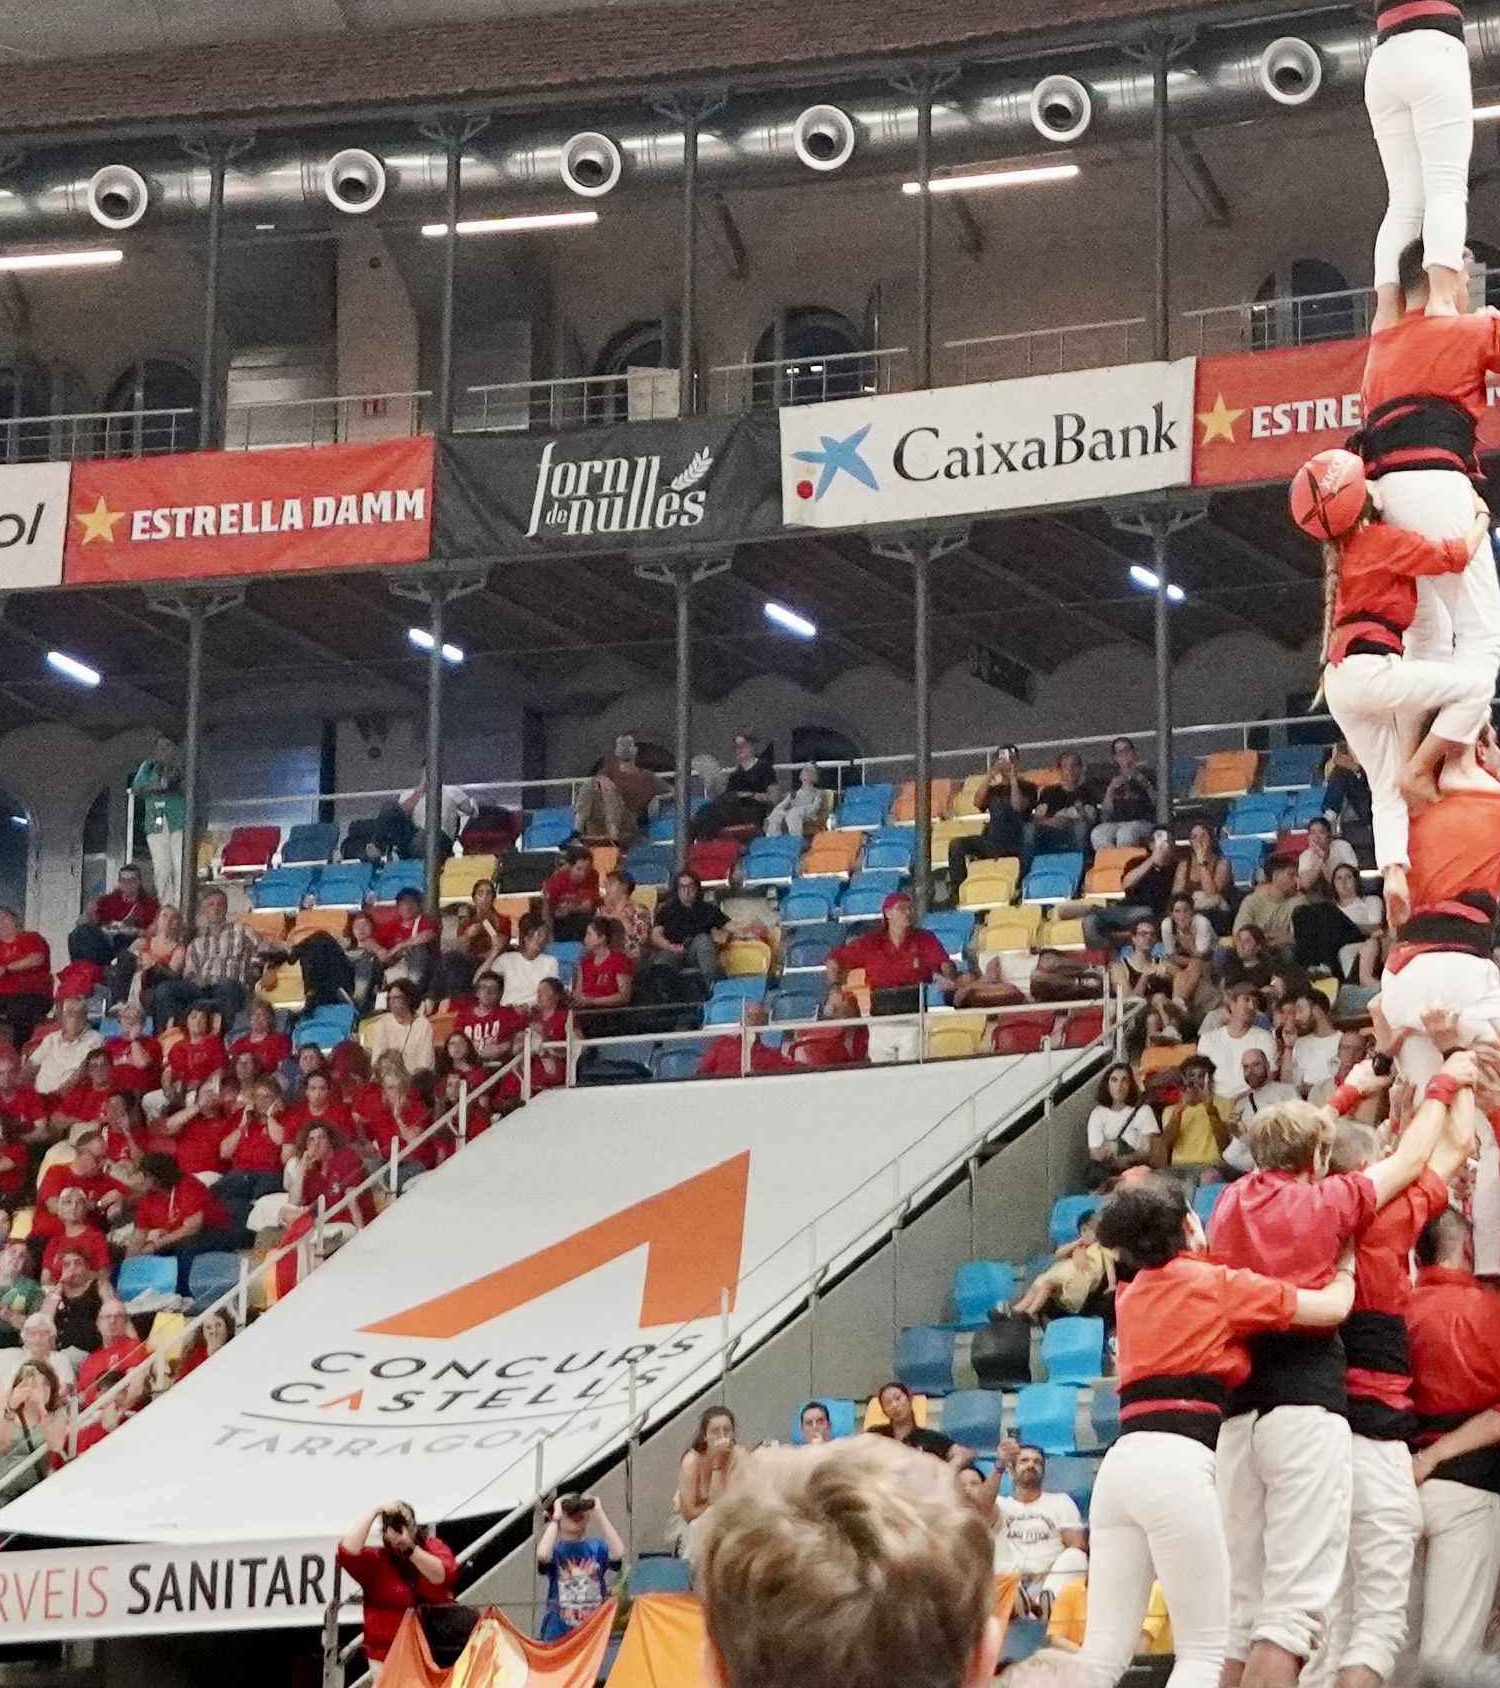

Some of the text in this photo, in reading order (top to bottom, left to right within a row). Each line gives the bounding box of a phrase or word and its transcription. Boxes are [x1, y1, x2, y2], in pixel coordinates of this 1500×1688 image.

[1250, 392, 1364, 439] ESTRE
[892, 400, 1180, 483] CaixaBank
[525, 441, 631, 538] forn
[130, 487, 425, 542] ESTRELLA DAMM
[544, 501, 568, 526] de
[311, 1334, 703, 1380] CONCURS
[270, 1366, 659, 1413] CASTELLS
[213, 1415, 602, 1456] TARRAGONA
